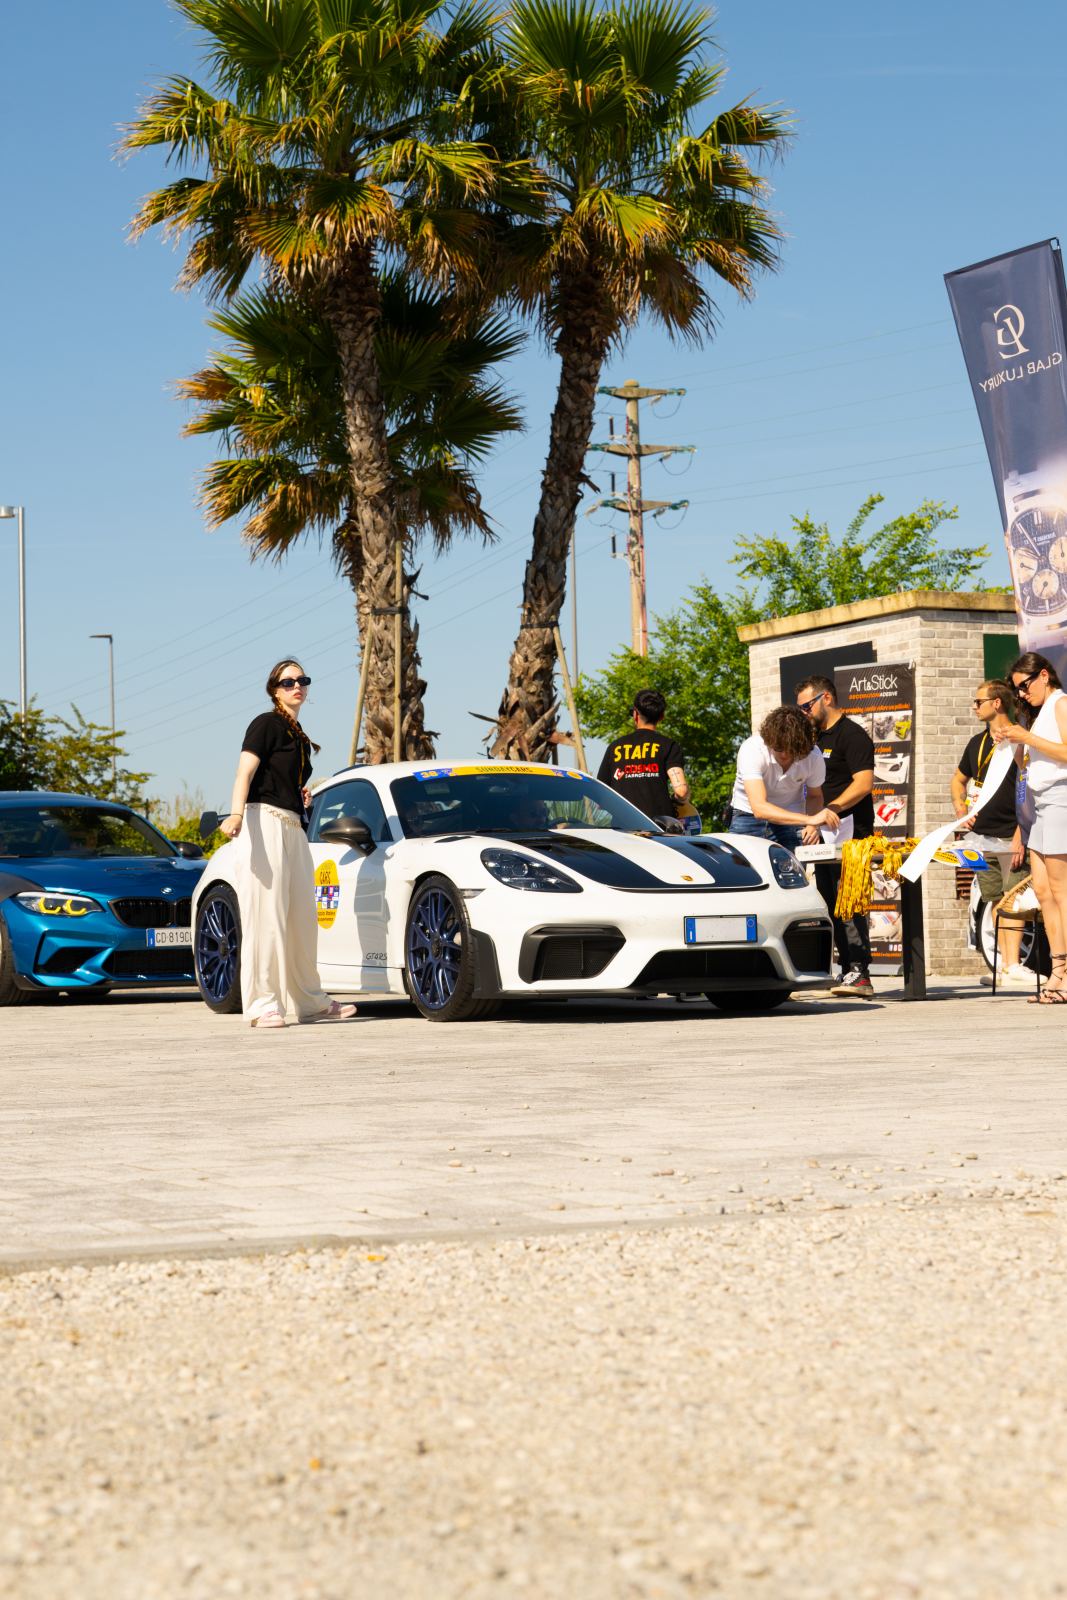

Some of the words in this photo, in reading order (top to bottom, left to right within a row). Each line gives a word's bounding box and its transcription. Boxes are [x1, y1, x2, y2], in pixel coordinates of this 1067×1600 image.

[849, 674, 898, 692] Art&Stick
[614, 742, 660, 763] STAFF
[624, 763, 659, 774] COSMO
